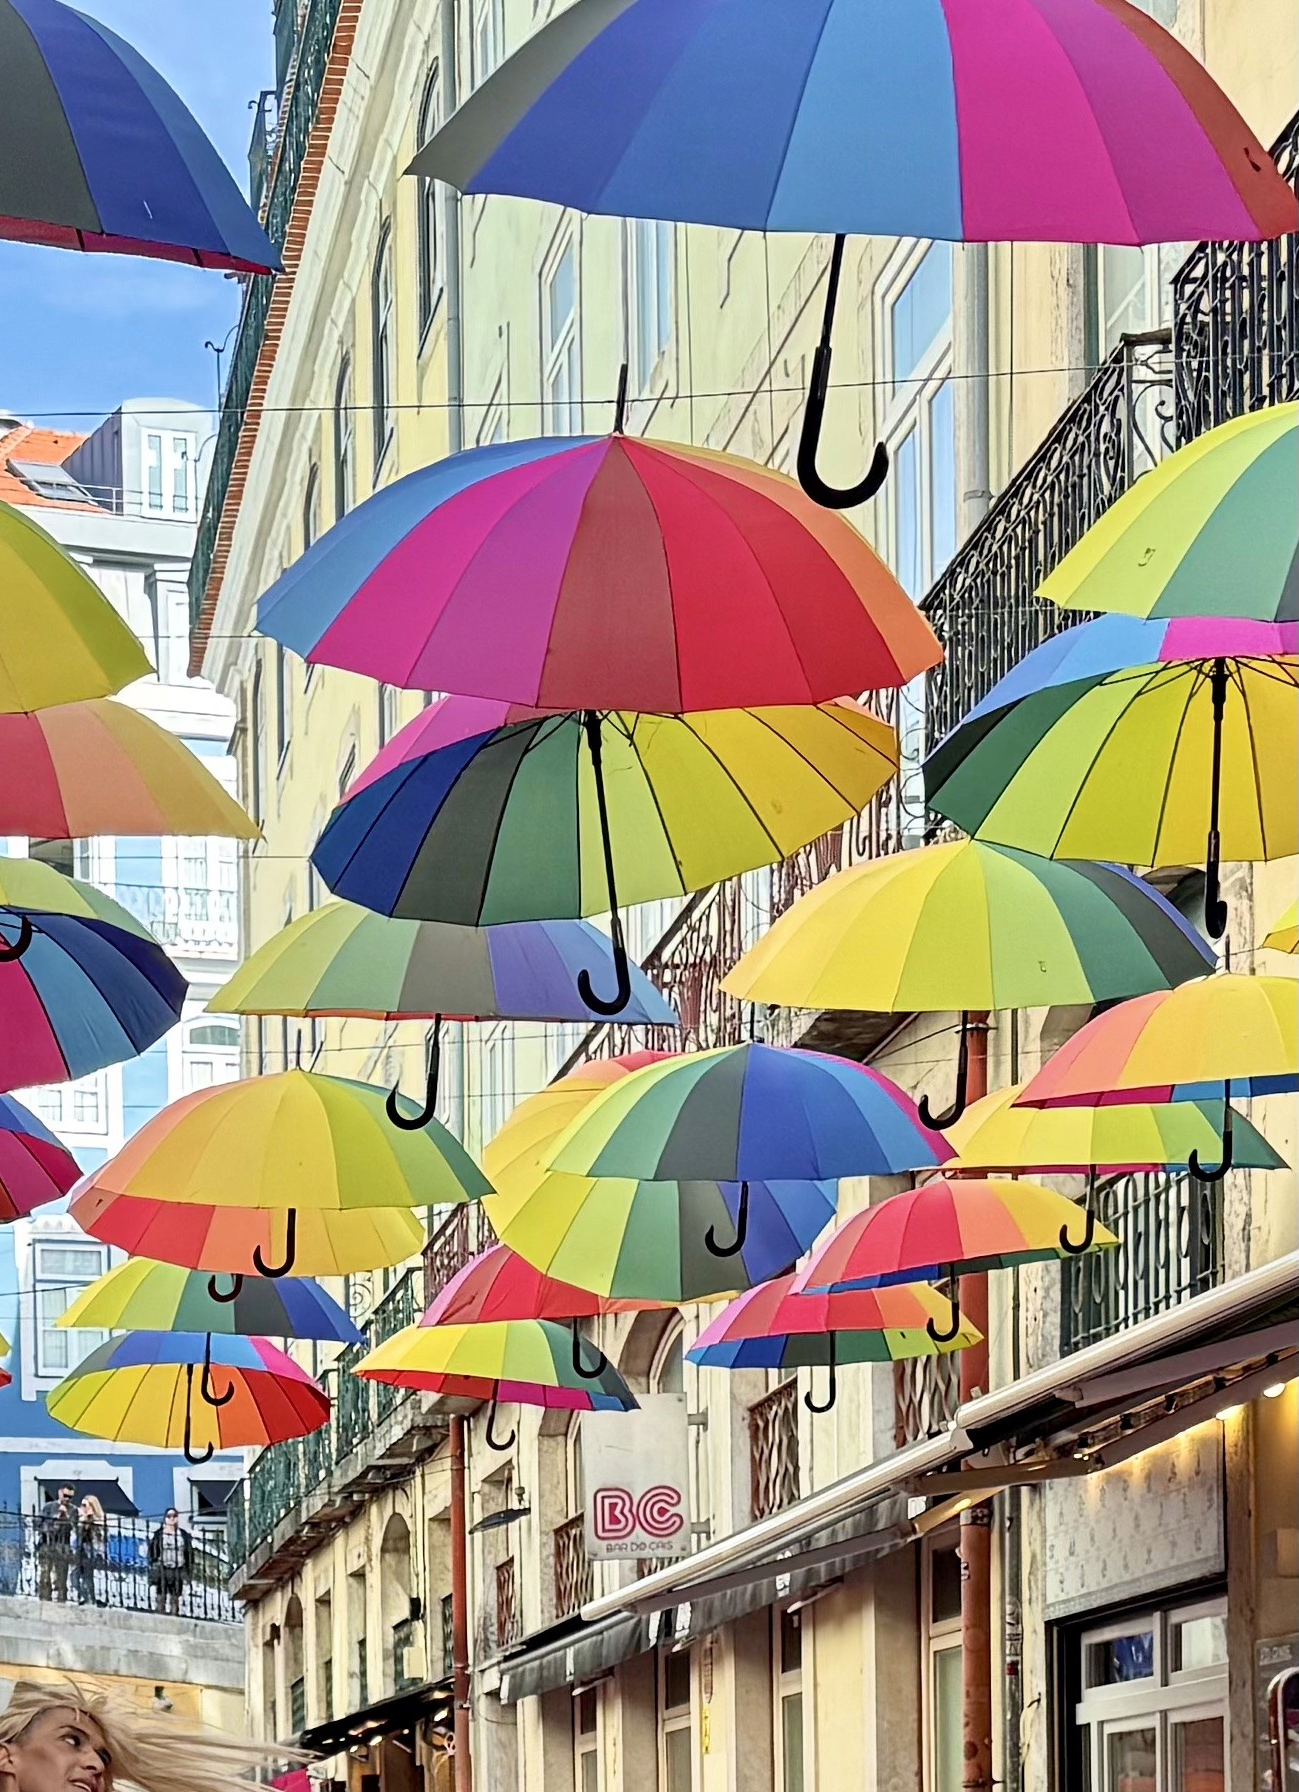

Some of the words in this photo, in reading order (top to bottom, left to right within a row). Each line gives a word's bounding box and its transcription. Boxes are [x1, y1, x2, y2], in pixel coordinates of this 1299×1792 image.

[594, 1485, 684, 1540] BC
[606, 1543, 628, 1553] BAR
[631, 1542, 646, 1552] DO
[649, 1540, 673, 1551] CAIS
